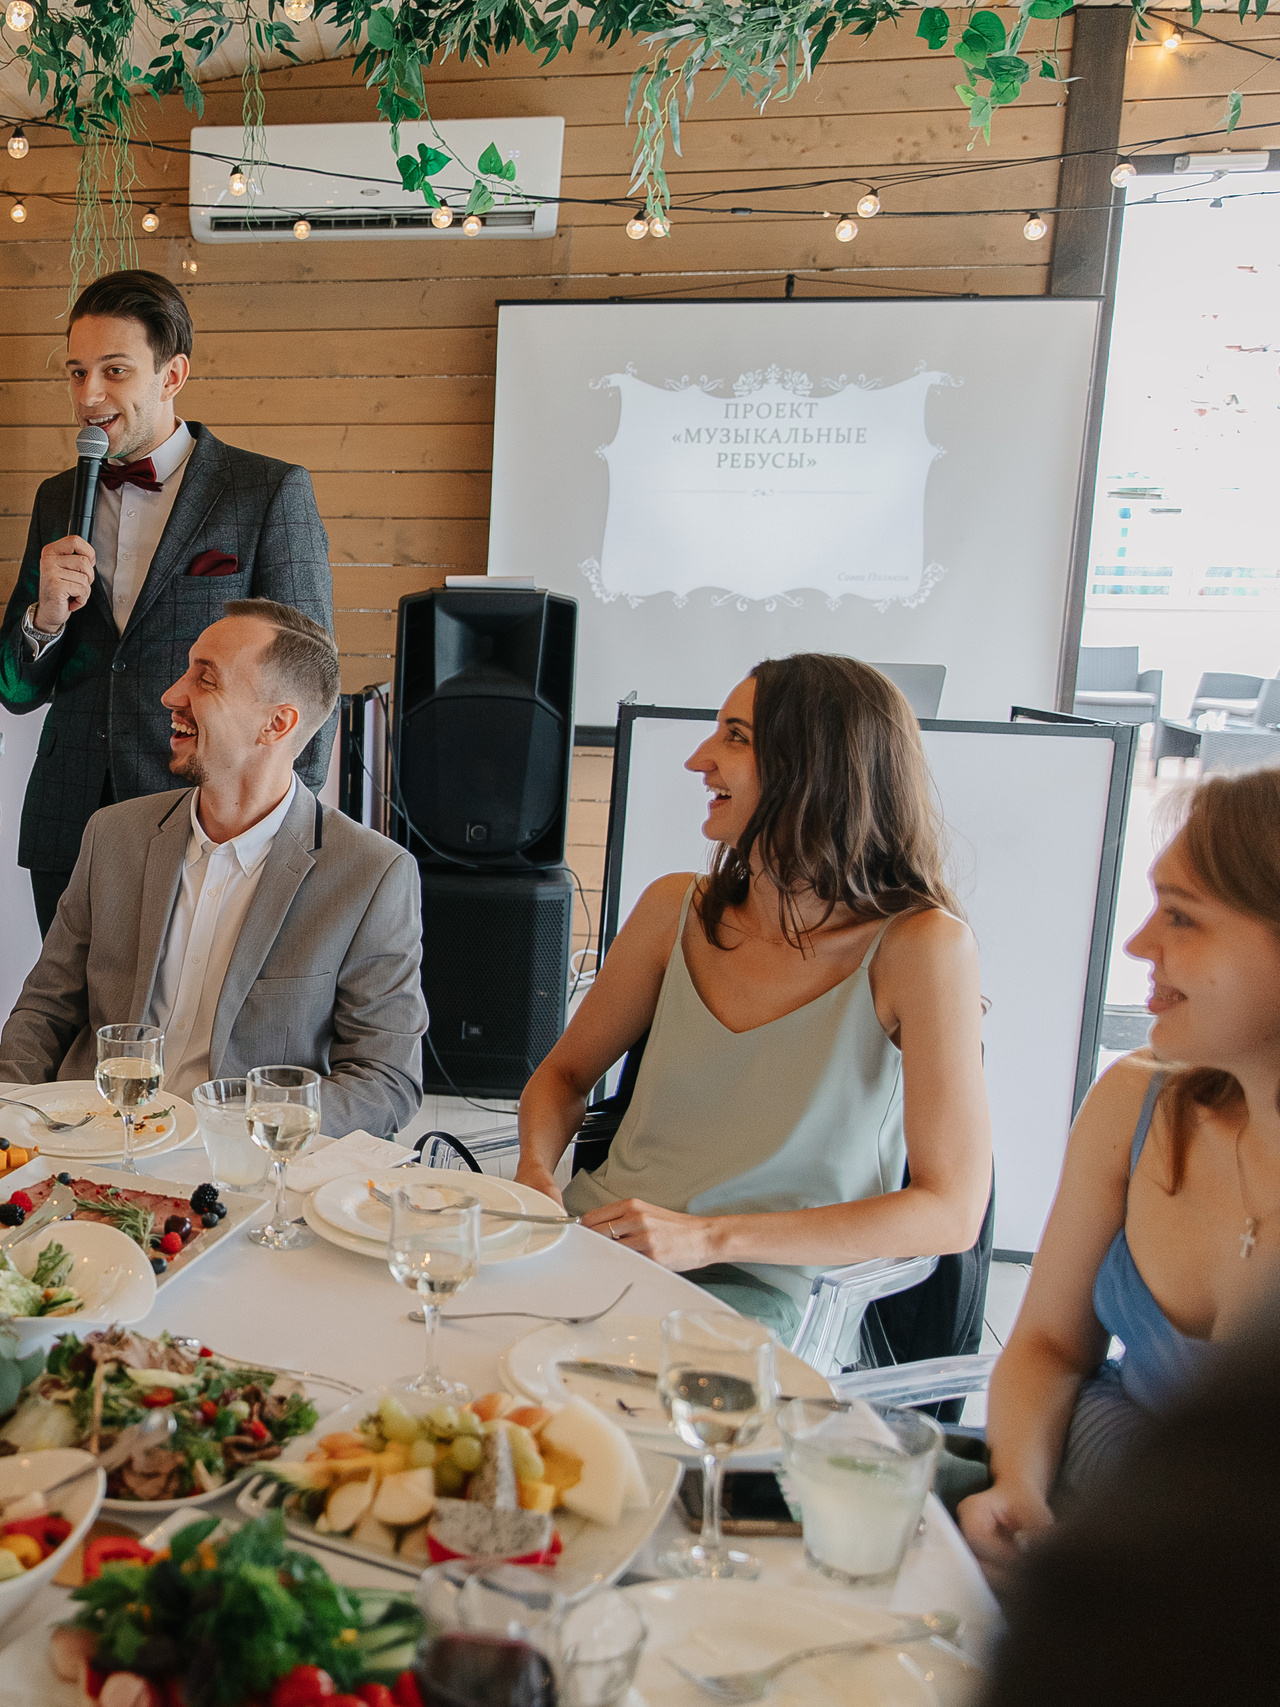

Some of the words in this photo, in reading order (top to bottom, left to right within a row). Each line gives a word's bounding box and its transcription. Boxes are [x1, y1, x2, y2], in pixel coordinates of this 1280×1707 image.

[723, 402, 819, 420] ПРОЕКТ
[671, 427, 868, 445] «МУЗЫКАЛЬНЫЕ
[715, 452, 818, 470] РЕБУСЫ»
